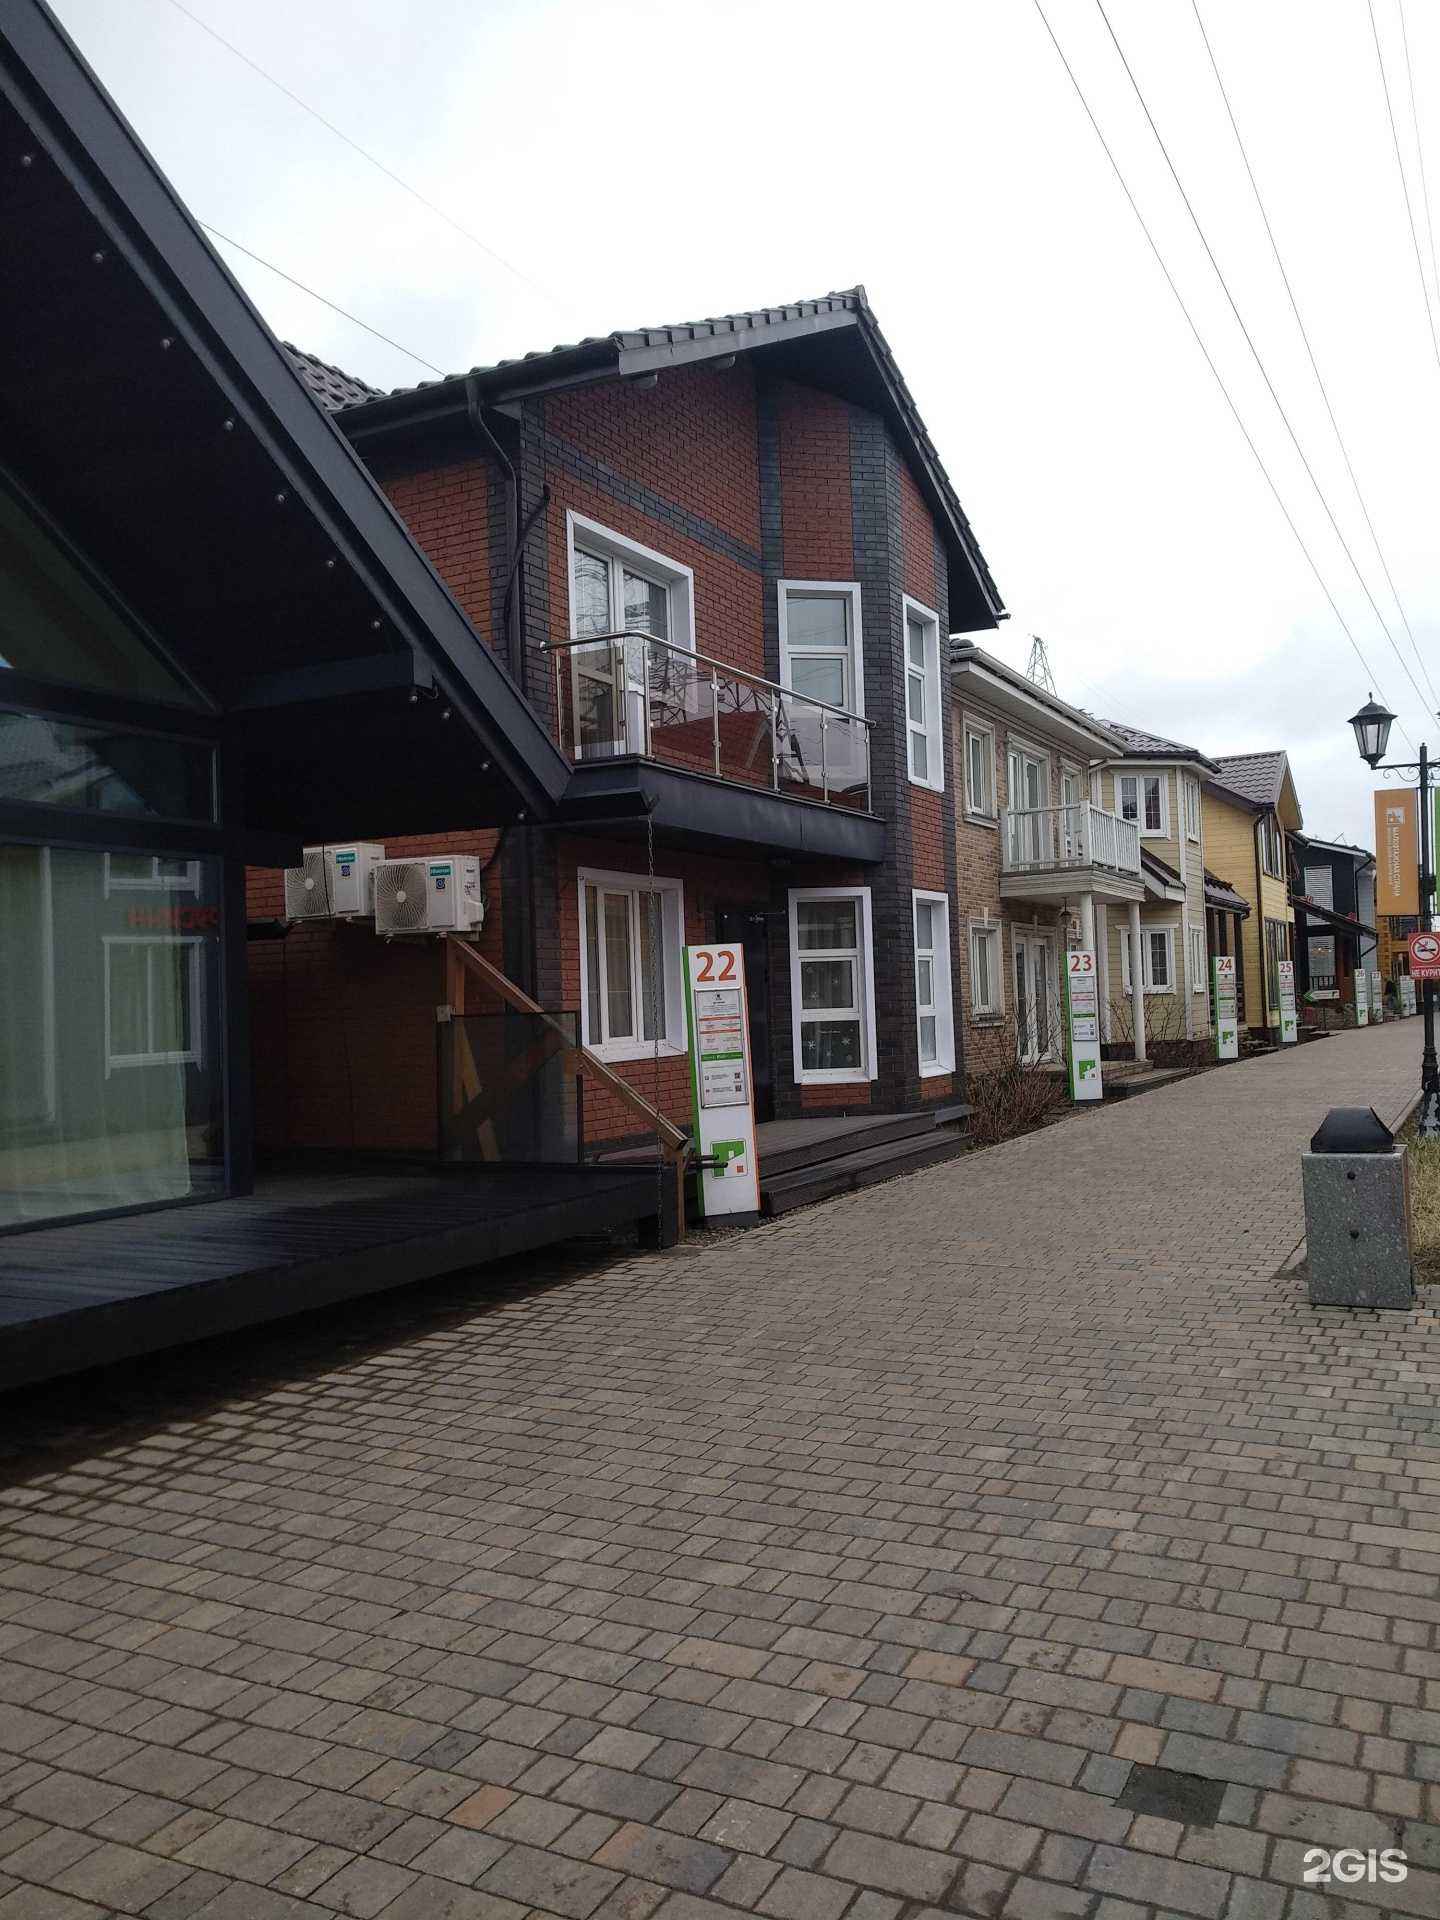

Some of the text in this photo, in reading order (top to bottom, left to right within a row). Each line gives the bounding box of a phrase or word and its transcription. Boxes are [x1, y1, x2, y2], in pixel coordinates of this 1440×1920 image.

[696, 951, 736, 982] 22
[1071, 955, 1092, 972] 23
[1218, 959, 1232, 971] 24
[1280, 963, 1291, 973] 25
[1409, 969, 1420, 977] НЕ
